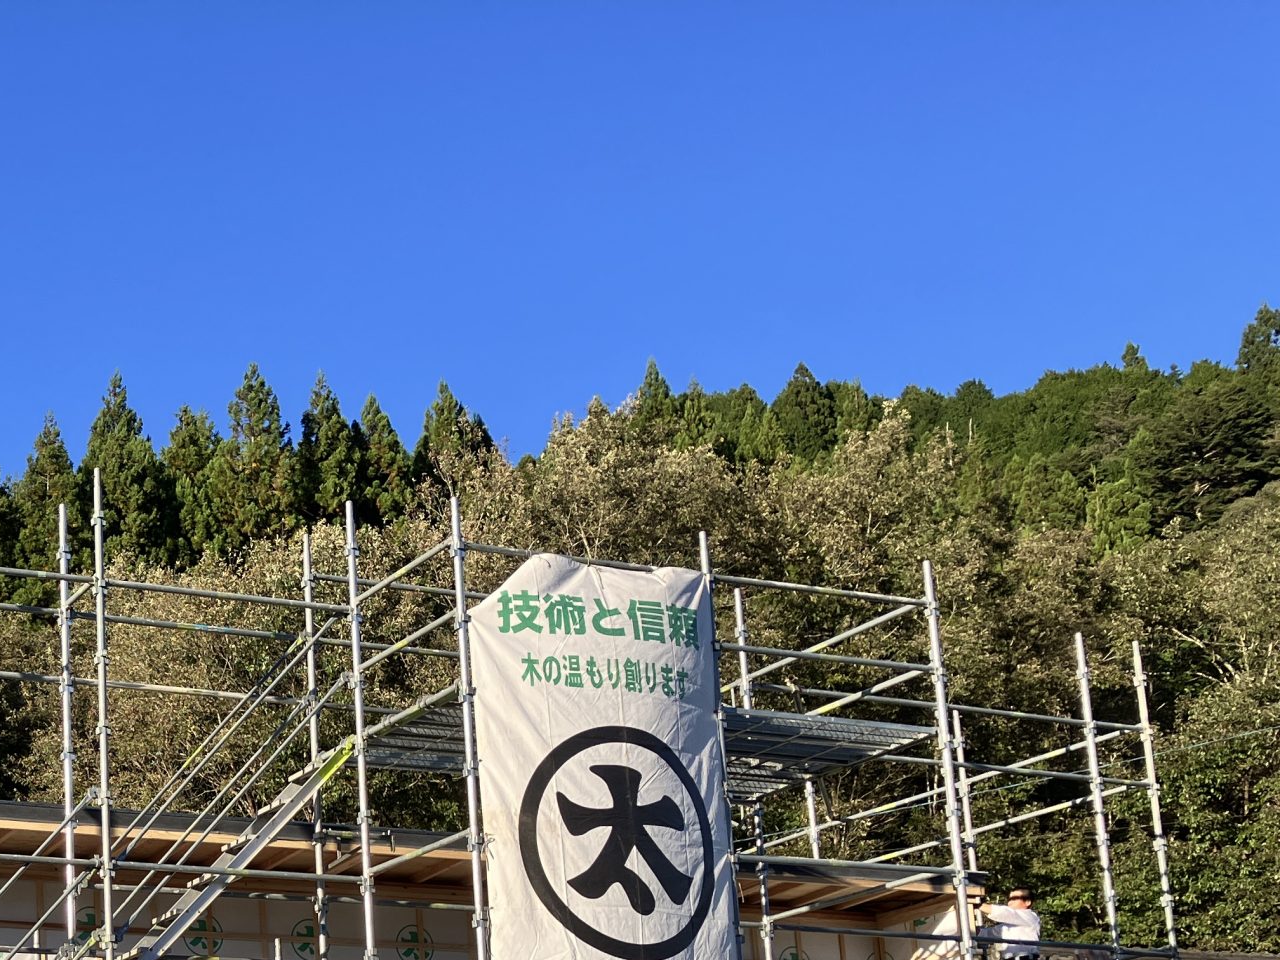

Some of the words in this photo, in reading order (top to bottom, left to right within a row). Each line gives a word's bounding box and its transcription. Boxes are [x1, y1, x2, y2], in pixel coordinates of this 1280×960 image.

[497, 589, 700, 650] 技術と信頼
[521, 652, 689, 700] 木の温もり創ります
